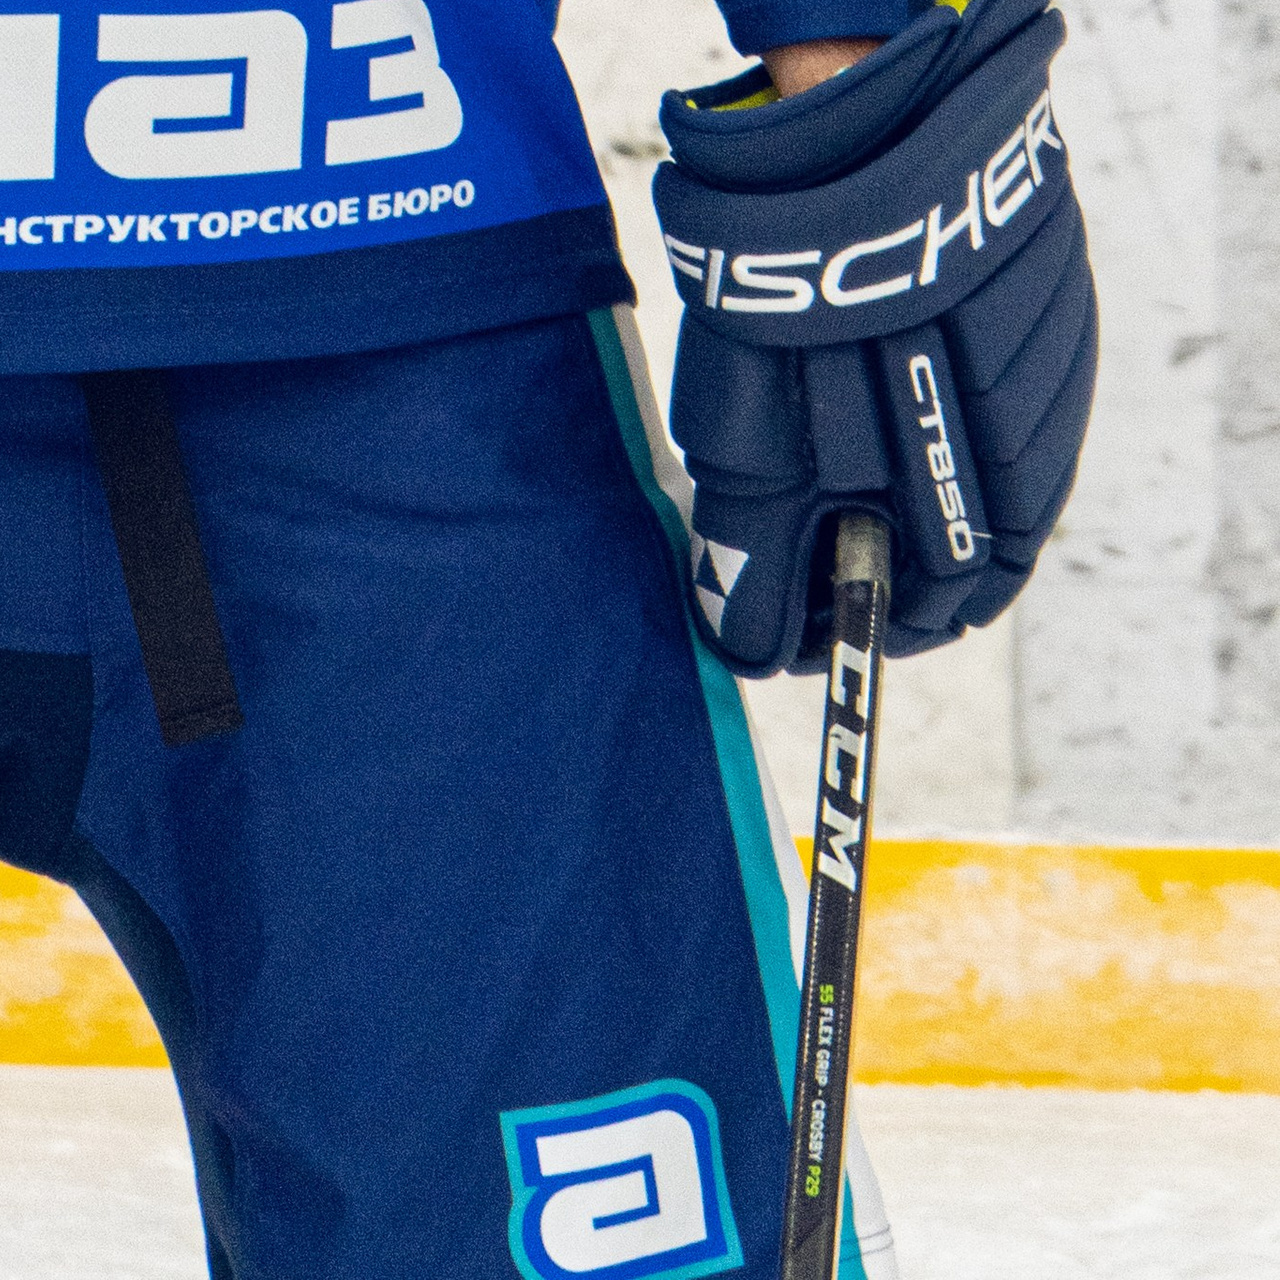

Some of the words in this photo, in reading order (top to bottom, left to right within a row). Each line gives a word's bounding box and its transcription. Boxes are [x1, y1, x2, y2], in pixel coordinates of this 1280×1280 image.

[366, 178, 475, 221] БЮРО
[908, 352, 976, 562] CT850
[817, 639, 872, 892] CCM
[817, 1006, 834, 1046] FLEX
[814, 1048, 831, 1088] GRIP
[807, 1098, 827, 1164] CROSBY
